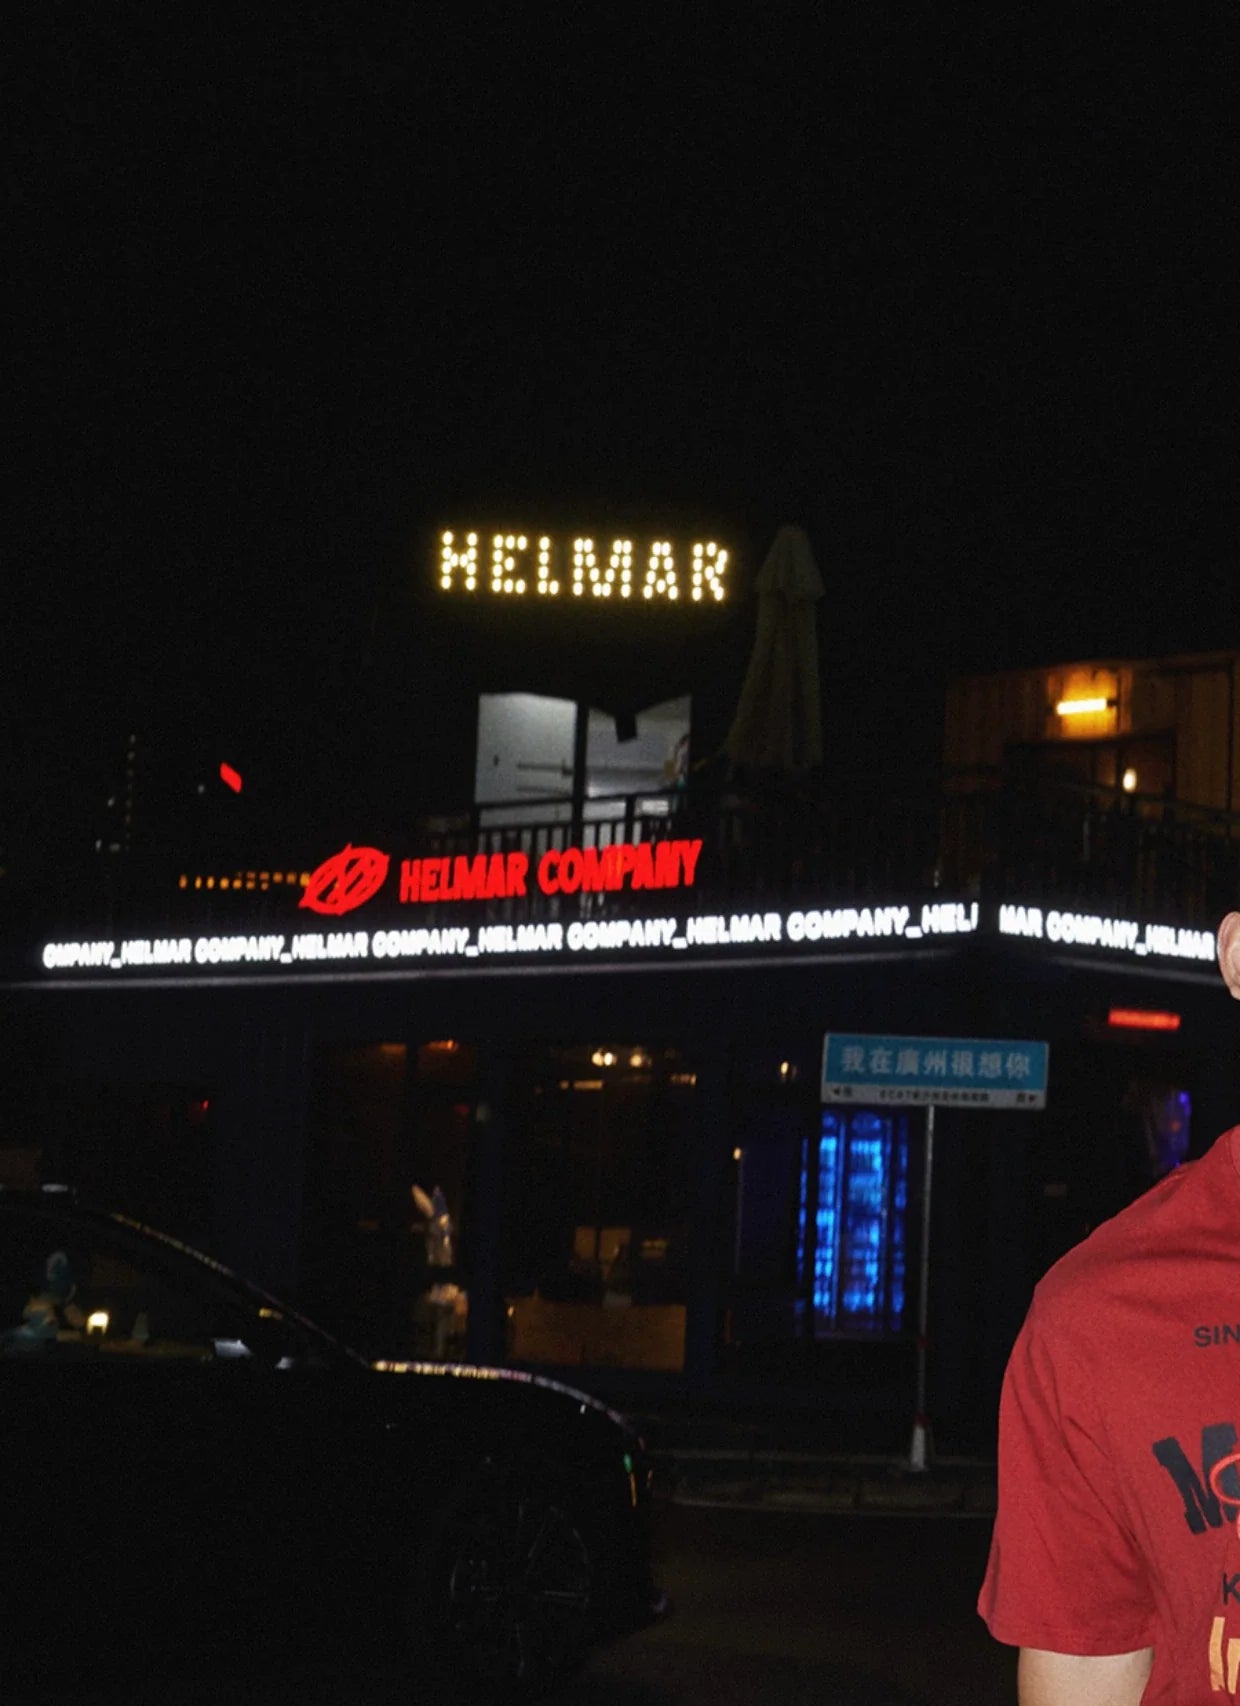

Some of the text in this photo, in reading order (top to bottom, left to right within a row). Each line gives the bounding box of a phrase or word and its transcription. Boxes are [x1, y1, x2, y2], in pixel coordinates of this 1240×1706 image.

[440, 530, 729, 601] HELMAR
[399, 839, 703, 903] HELMAR COMPANY
